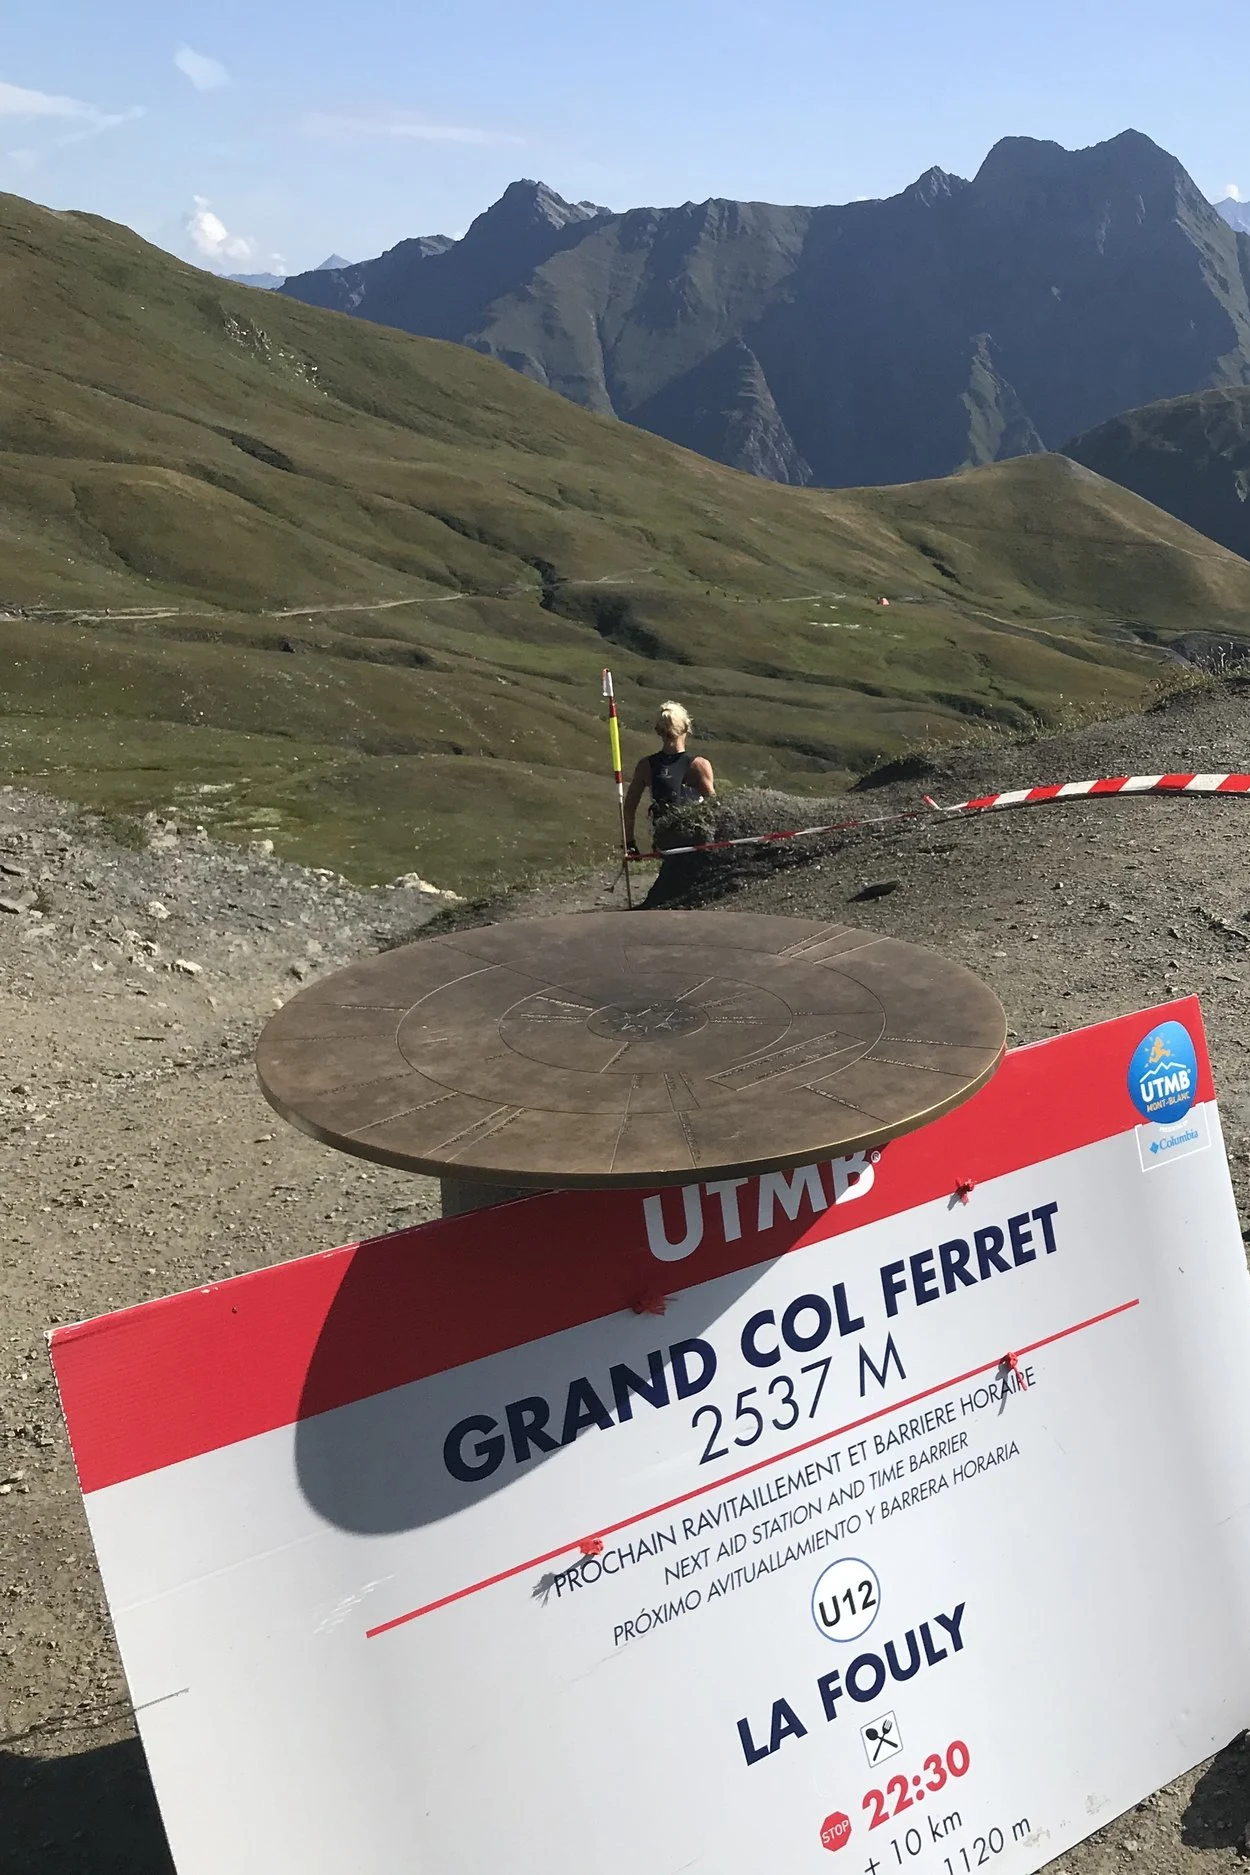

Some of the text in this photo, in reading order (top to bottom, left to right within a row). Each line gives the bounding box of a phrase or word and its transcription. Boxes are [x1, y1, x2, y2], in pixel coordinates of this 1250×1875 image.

[1140, 1070, 1191, 1103] UTMB
[1159, 1128, 1199, 1150] Columbia
[443, 1201, 1059, 1482] GRAND COL FERRET
[691, 1332, 907, 1466] 2537 M
[553, 1366, 1036, 1597] PROCHAIN RAVITAILLEMENT ET BARRIERE HORAIRE
[664, 1431, 969, 1585] NEXT AID STATION AND TIME BARRIER
[613, 1441, 1020, 1646] PRÓXIMO AVITUALLAMIENTO Y BARRERA HORARIA
[818, 1580, 877, 1628] U12
[737, 1601, 966, 1767] LA FOULY
[862, 1740, 970, 1831] 22:30
[1012, 1818, 1031, 1841] m
[821, 1819, 849, 1844] STOP
[890, 1828, 922, 1865] 10
[927, 1811, 963, 1843] km
